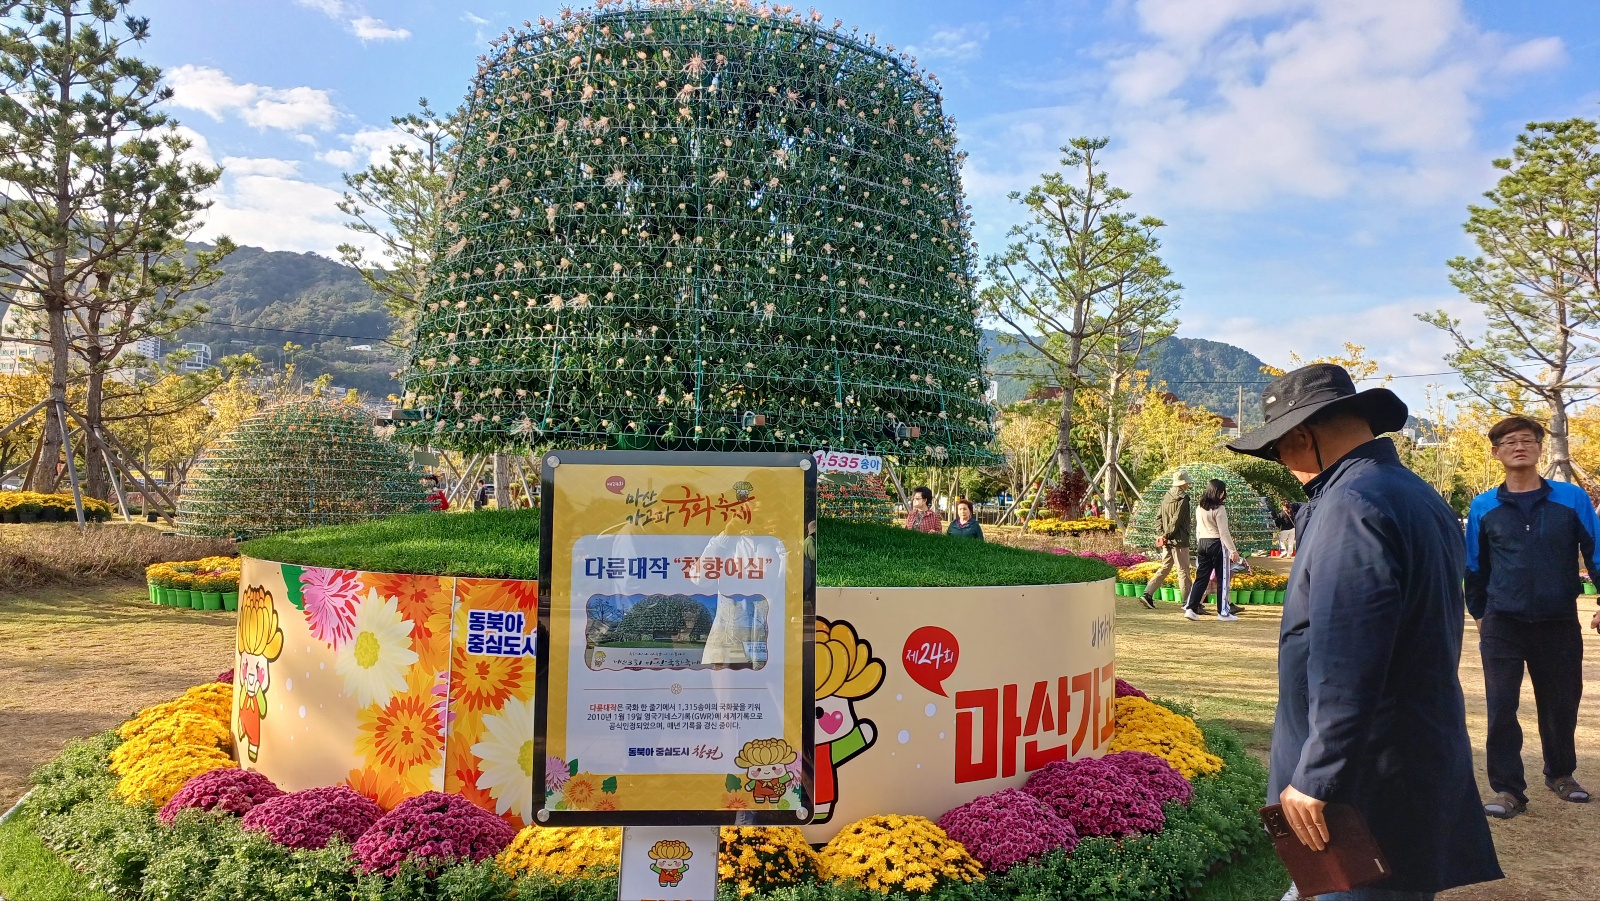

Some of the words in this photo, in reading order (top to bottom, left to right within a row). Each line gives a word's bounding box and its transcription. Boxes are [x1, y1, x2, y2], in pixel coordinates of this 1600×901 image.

[816, 453, 880, 470] 1,535송이
[625, 488, 658, 508] 마산
[625, 505, 676, 526] 가고파
[584, 556, 671, 580] 다륜대작
[469, 611, 524, 634] 동북아
[905, 642, 954, 669] 제24회
[625, 703, 639, 712] 국화
[640, 703, 648, 712] 한
[649, 703, 676, 712] 줄기에서
[677, 703, 718, 712] 1,315송이의
[719, 703, 746, 712] 국화꽃을
[747, 703, 761, 712] 키워
[587, 713, 612, 721] 2010년
[614, 713, 625, 721] 1월
[627, 713, 642, 721] 19일
[644, 713, 722, 721] 영국기네스기록(GWR)에
[723, 713, 763, 721] 세계기록으로
[609, 722, 665, 731] 공식인정되었으며,
[666, 722, 681, 731] 매년
[682, 722, 702, 731] 기록을
[718, 722, 741, 731] 중이다.
[628, 747, 654, 757] 동북아
[655, 747, 690, 757] 중심도시
[691, 744, 724, 760] 창원
